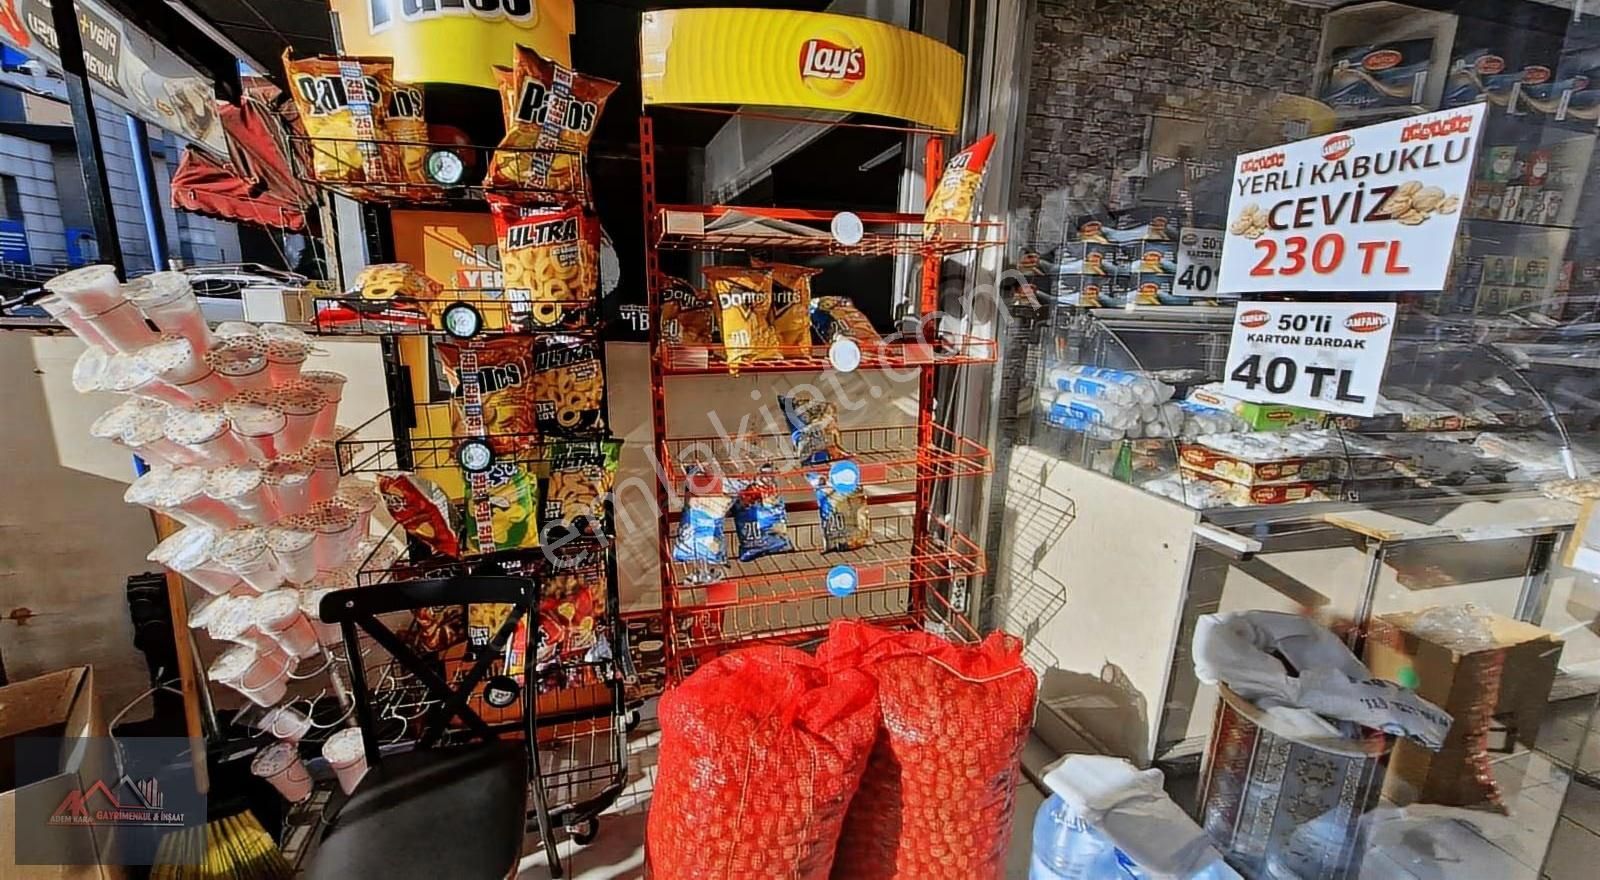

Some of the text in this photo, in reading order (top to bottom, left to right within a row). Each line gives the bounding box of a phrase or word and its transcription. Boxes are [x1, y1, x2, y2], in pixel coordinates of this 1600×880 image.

[803, 41, 863, 79] Lay's
[1237, 137, 1471, 196] YERLİ KABUKLU
[1268, 182, 1400, 231] CEVİZ
[508, 217, 578, 250] ULTRA
[1250, 234, 1410, 276] 230 TL
[1178, 264, 1212, 291] 40
[1247, 333, 1367, 349] KARTON BARDAK
[1278, 314, 1332, 333] 50'li
[1231, 354, 1366, 404] 40 TL
